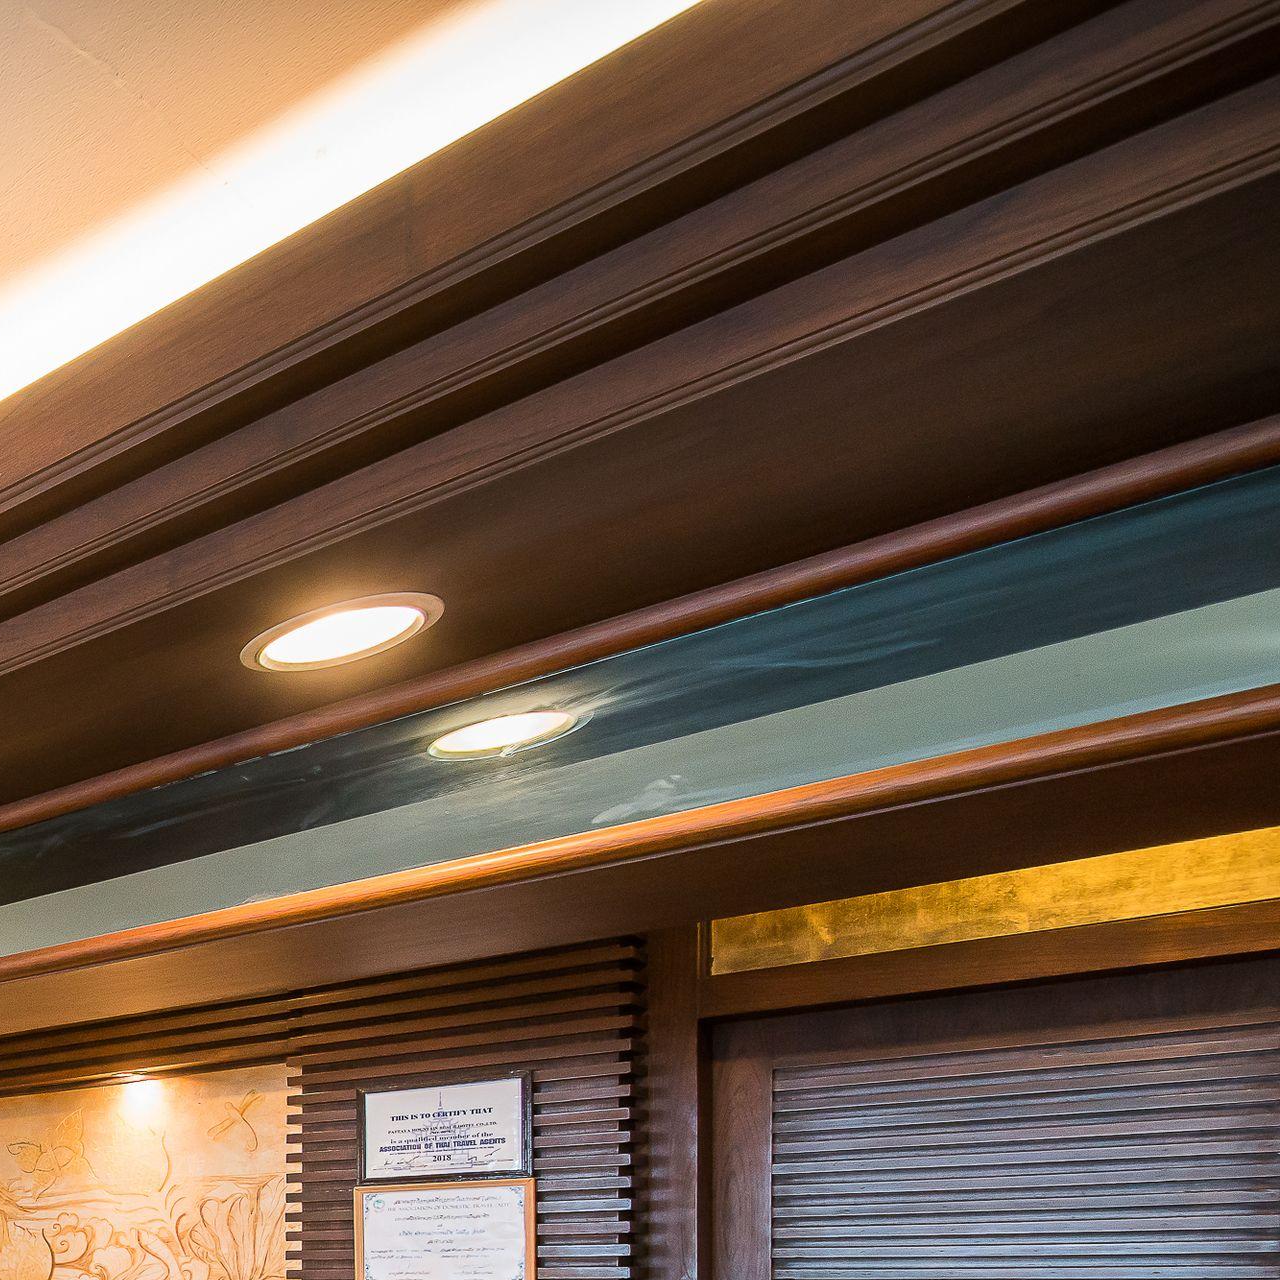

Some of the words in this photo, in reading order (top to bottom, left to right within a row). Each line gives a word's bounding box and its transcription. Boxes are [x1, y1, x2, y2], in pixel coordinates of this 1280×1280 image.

[432, 1110, 467, 1118] CERTIFY
[379, 1142, 422, 1152] ASSOCIATION
[435, 1141, 450, 1149] THAI
[453, 1139, 477, 1147] TRAVEL
[480, 1137, 506, 1146] AGENTS
[432, 1154, 452, 1162] 2018
